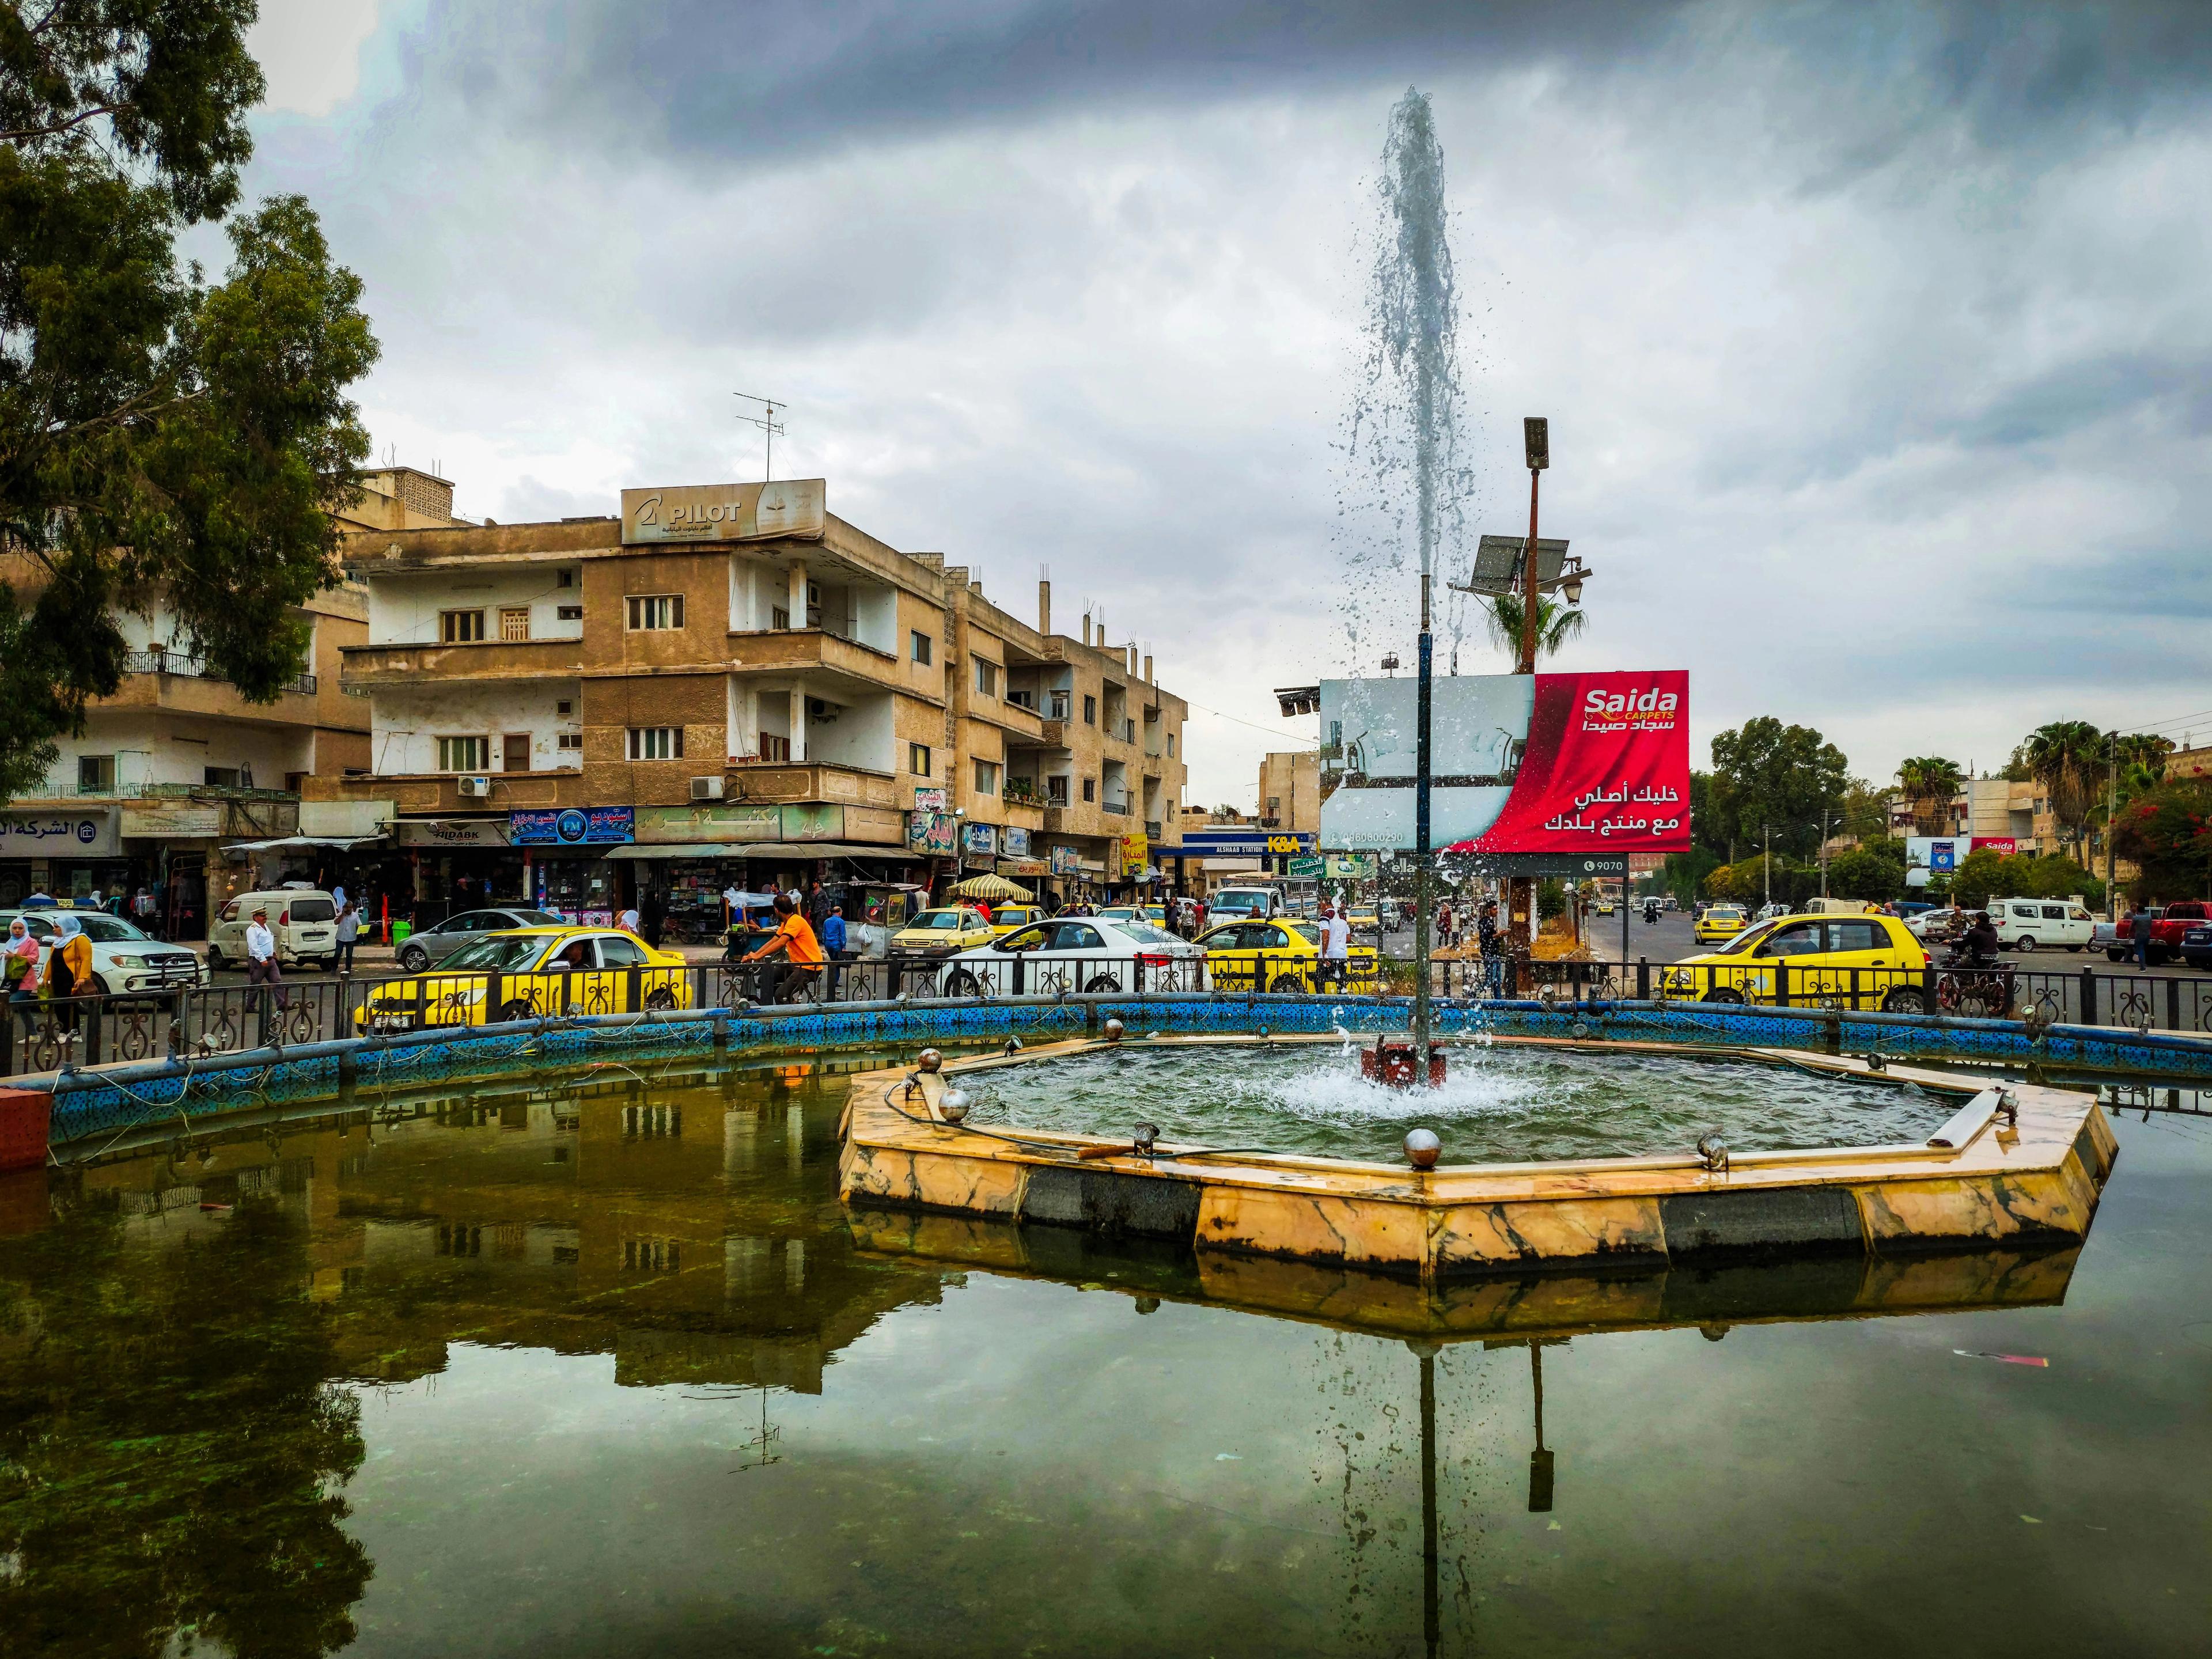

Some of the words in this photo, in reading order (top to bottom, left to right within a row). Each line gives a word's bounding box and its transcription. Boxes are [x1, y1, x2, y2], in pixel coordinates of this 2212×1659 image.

[670, 502, 741, 524] PILOT
[1585, 688, 1678, 712] Saida
[1625, 711, 1675, 719] CARPETS
[1582, 721, 1627, 733] صيدا
[1630, 719, 1675, 732] سجاد
[1574, 781, 1628, 810] أصلي
[1633, 786, 1679, 805] خليك
[564, 821, 581, 831] FM
[1545, 814, 1595, 833] بلدك
[1600, 815, 1647, 836] منتج
[1652, 818, 1679, 836] مع
[433, 831, 480, 840] ALDABK
[1268, 836, 1301, 853] K&A
[1123, 849, 1146, 862] المنارة
[1392, 858, 1415, 873] ella
[1597, 862, 1623, 870] 9070
